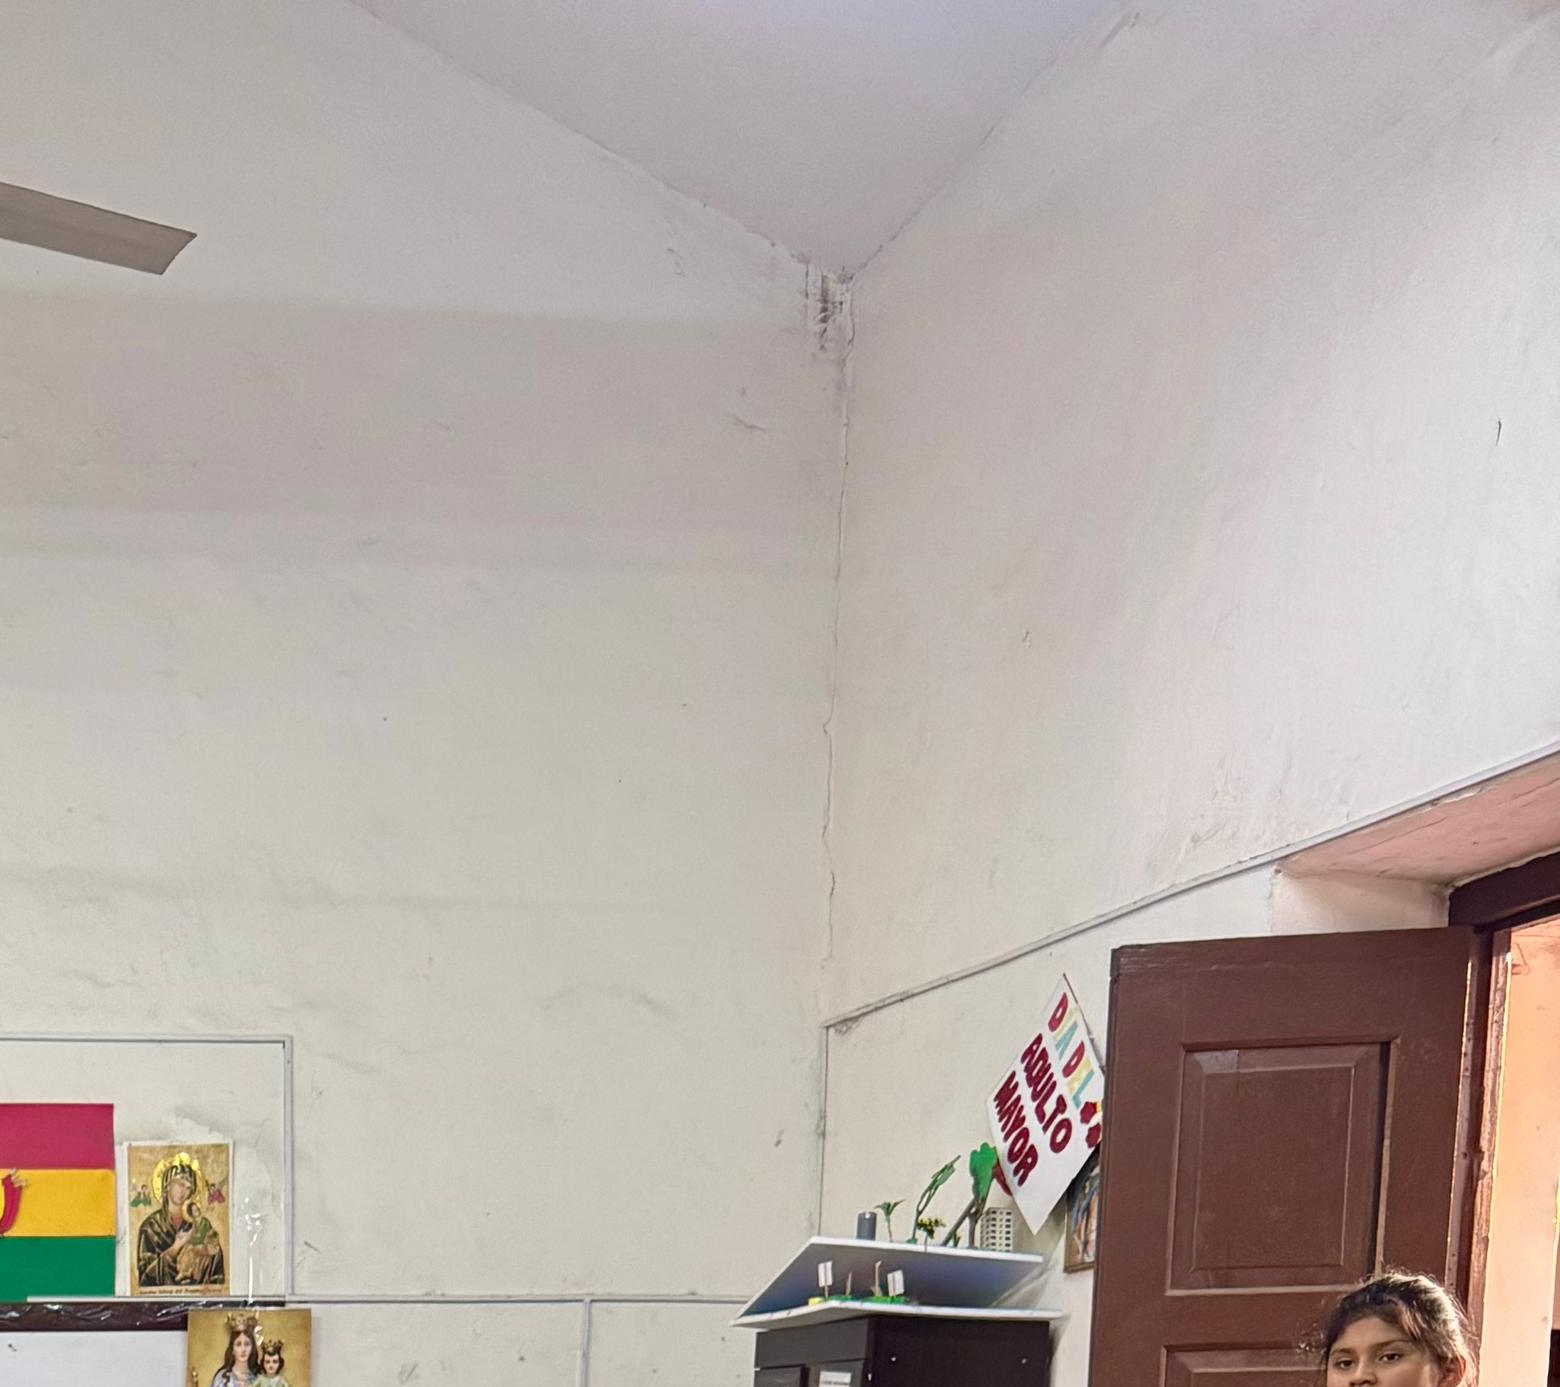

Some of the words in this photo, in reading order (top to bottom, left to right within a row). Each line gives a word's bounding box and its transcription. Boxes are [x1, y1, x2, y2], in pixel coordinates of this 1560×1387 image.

[993, 1070, 1039, 1187] MAYOR
[1021, 1033, 1072, 1154] ADULTO
[1062, 1041, 1095, 1109] DEL
